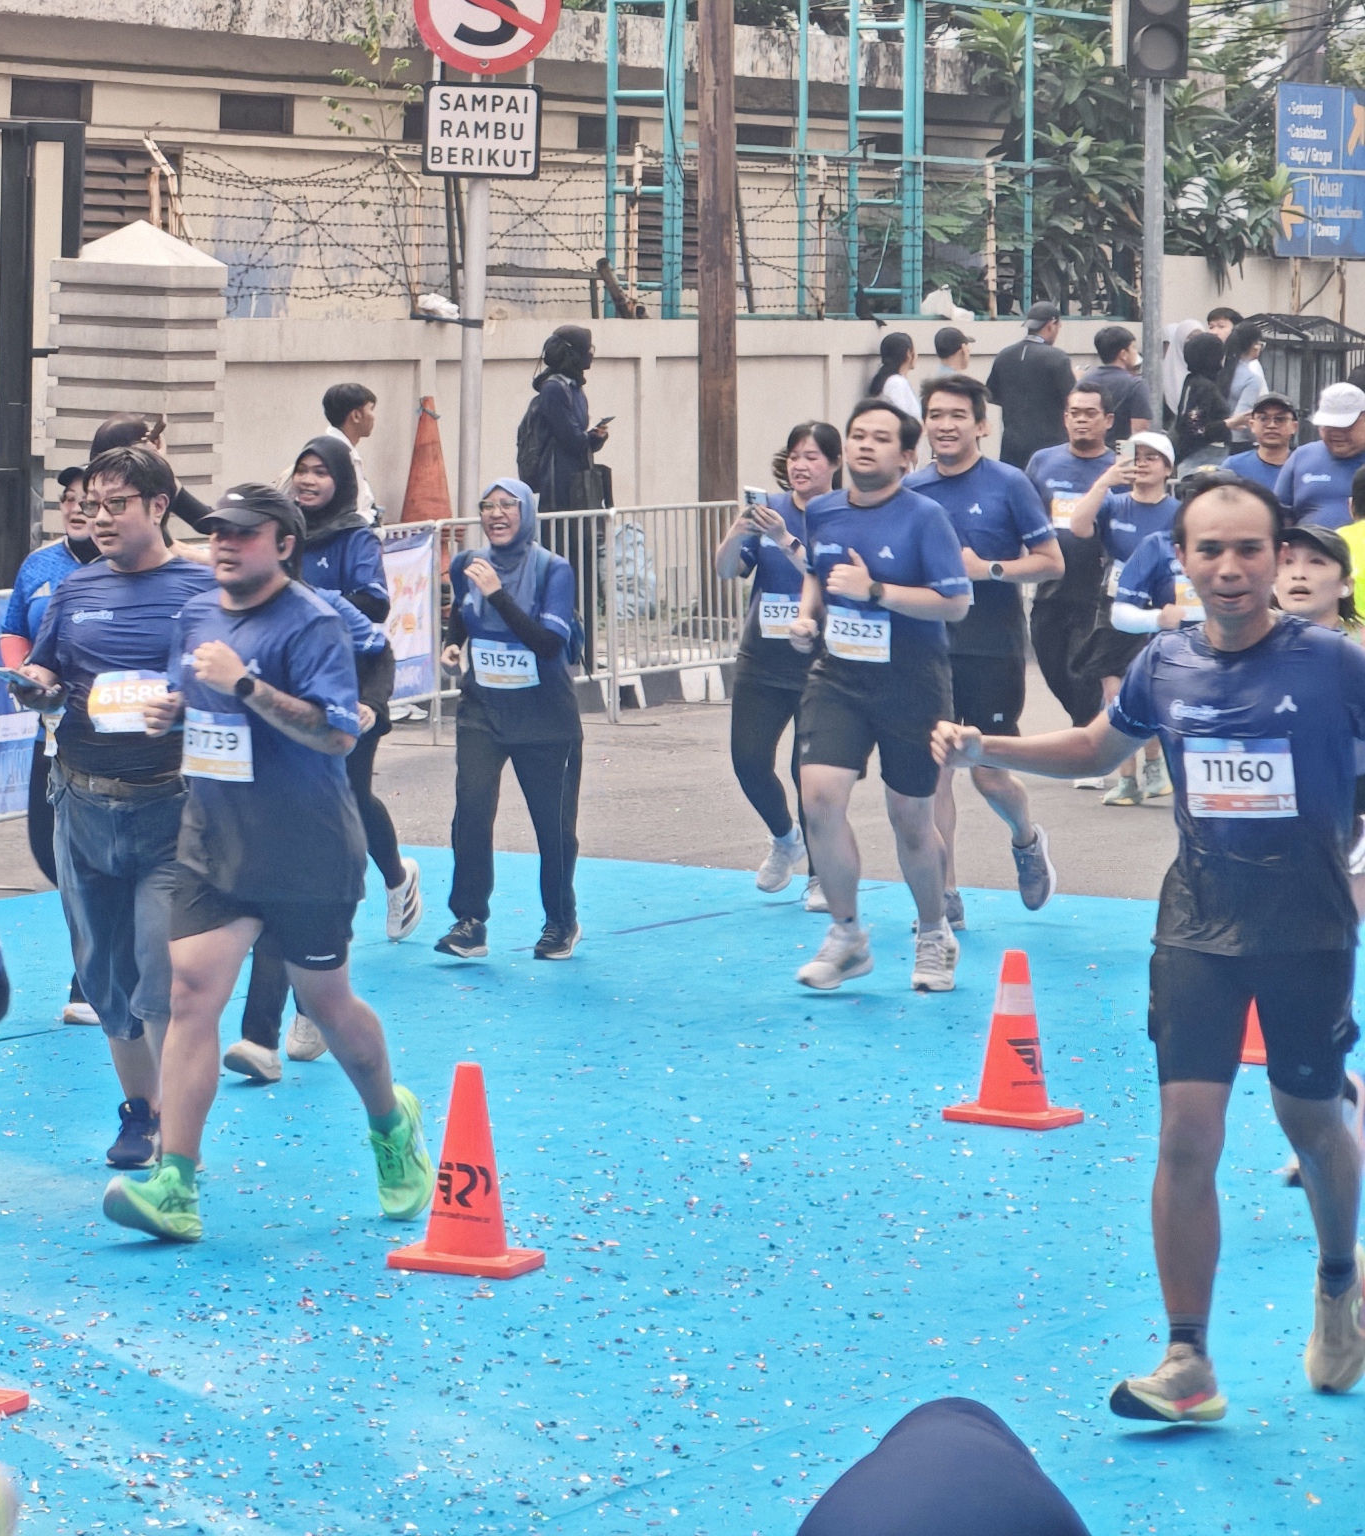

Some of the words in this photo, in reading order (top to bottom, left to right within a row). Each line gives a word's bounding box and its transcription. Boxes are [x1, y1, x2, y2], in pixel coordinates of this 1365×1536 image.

[439, 93, 529, 114] SAMPAI
[440, 120, 525, 140] RAMBU
[431, 147, 532, 168] BERIKUT
[1314, 176, 1343, 197] Keluar
[763, 605, 800, 619] 5379
[831, 619, 883, 639] 52523
[481, 652, 528, 668] 51574
[1202, 759, 1273, 782] 11160
